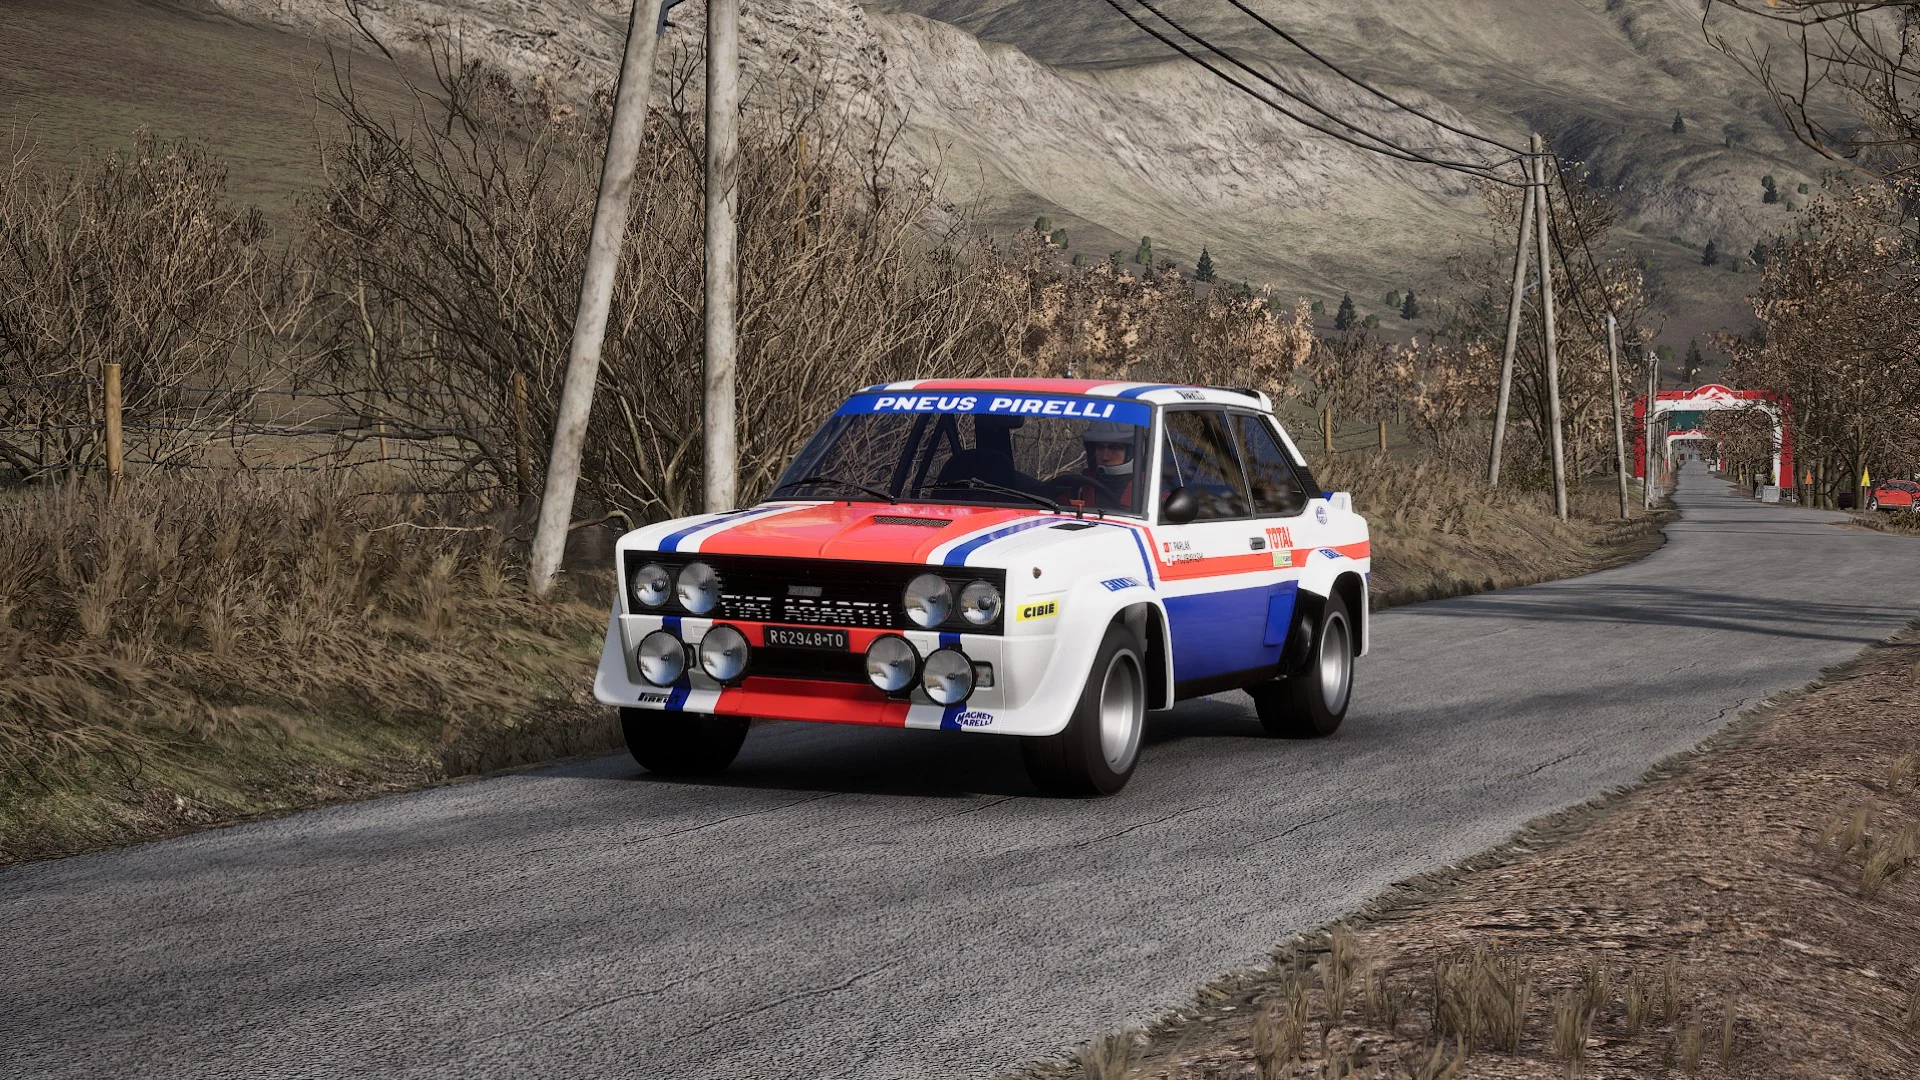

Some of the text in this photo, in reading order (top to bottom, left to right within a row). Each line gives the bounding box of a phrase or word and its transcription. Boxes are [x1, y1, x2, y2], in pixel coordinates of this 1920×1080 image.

[873, 396, 1115, 418] PNEUS PIRELLI
[1265, 526, 1294, 549] TOTAL
